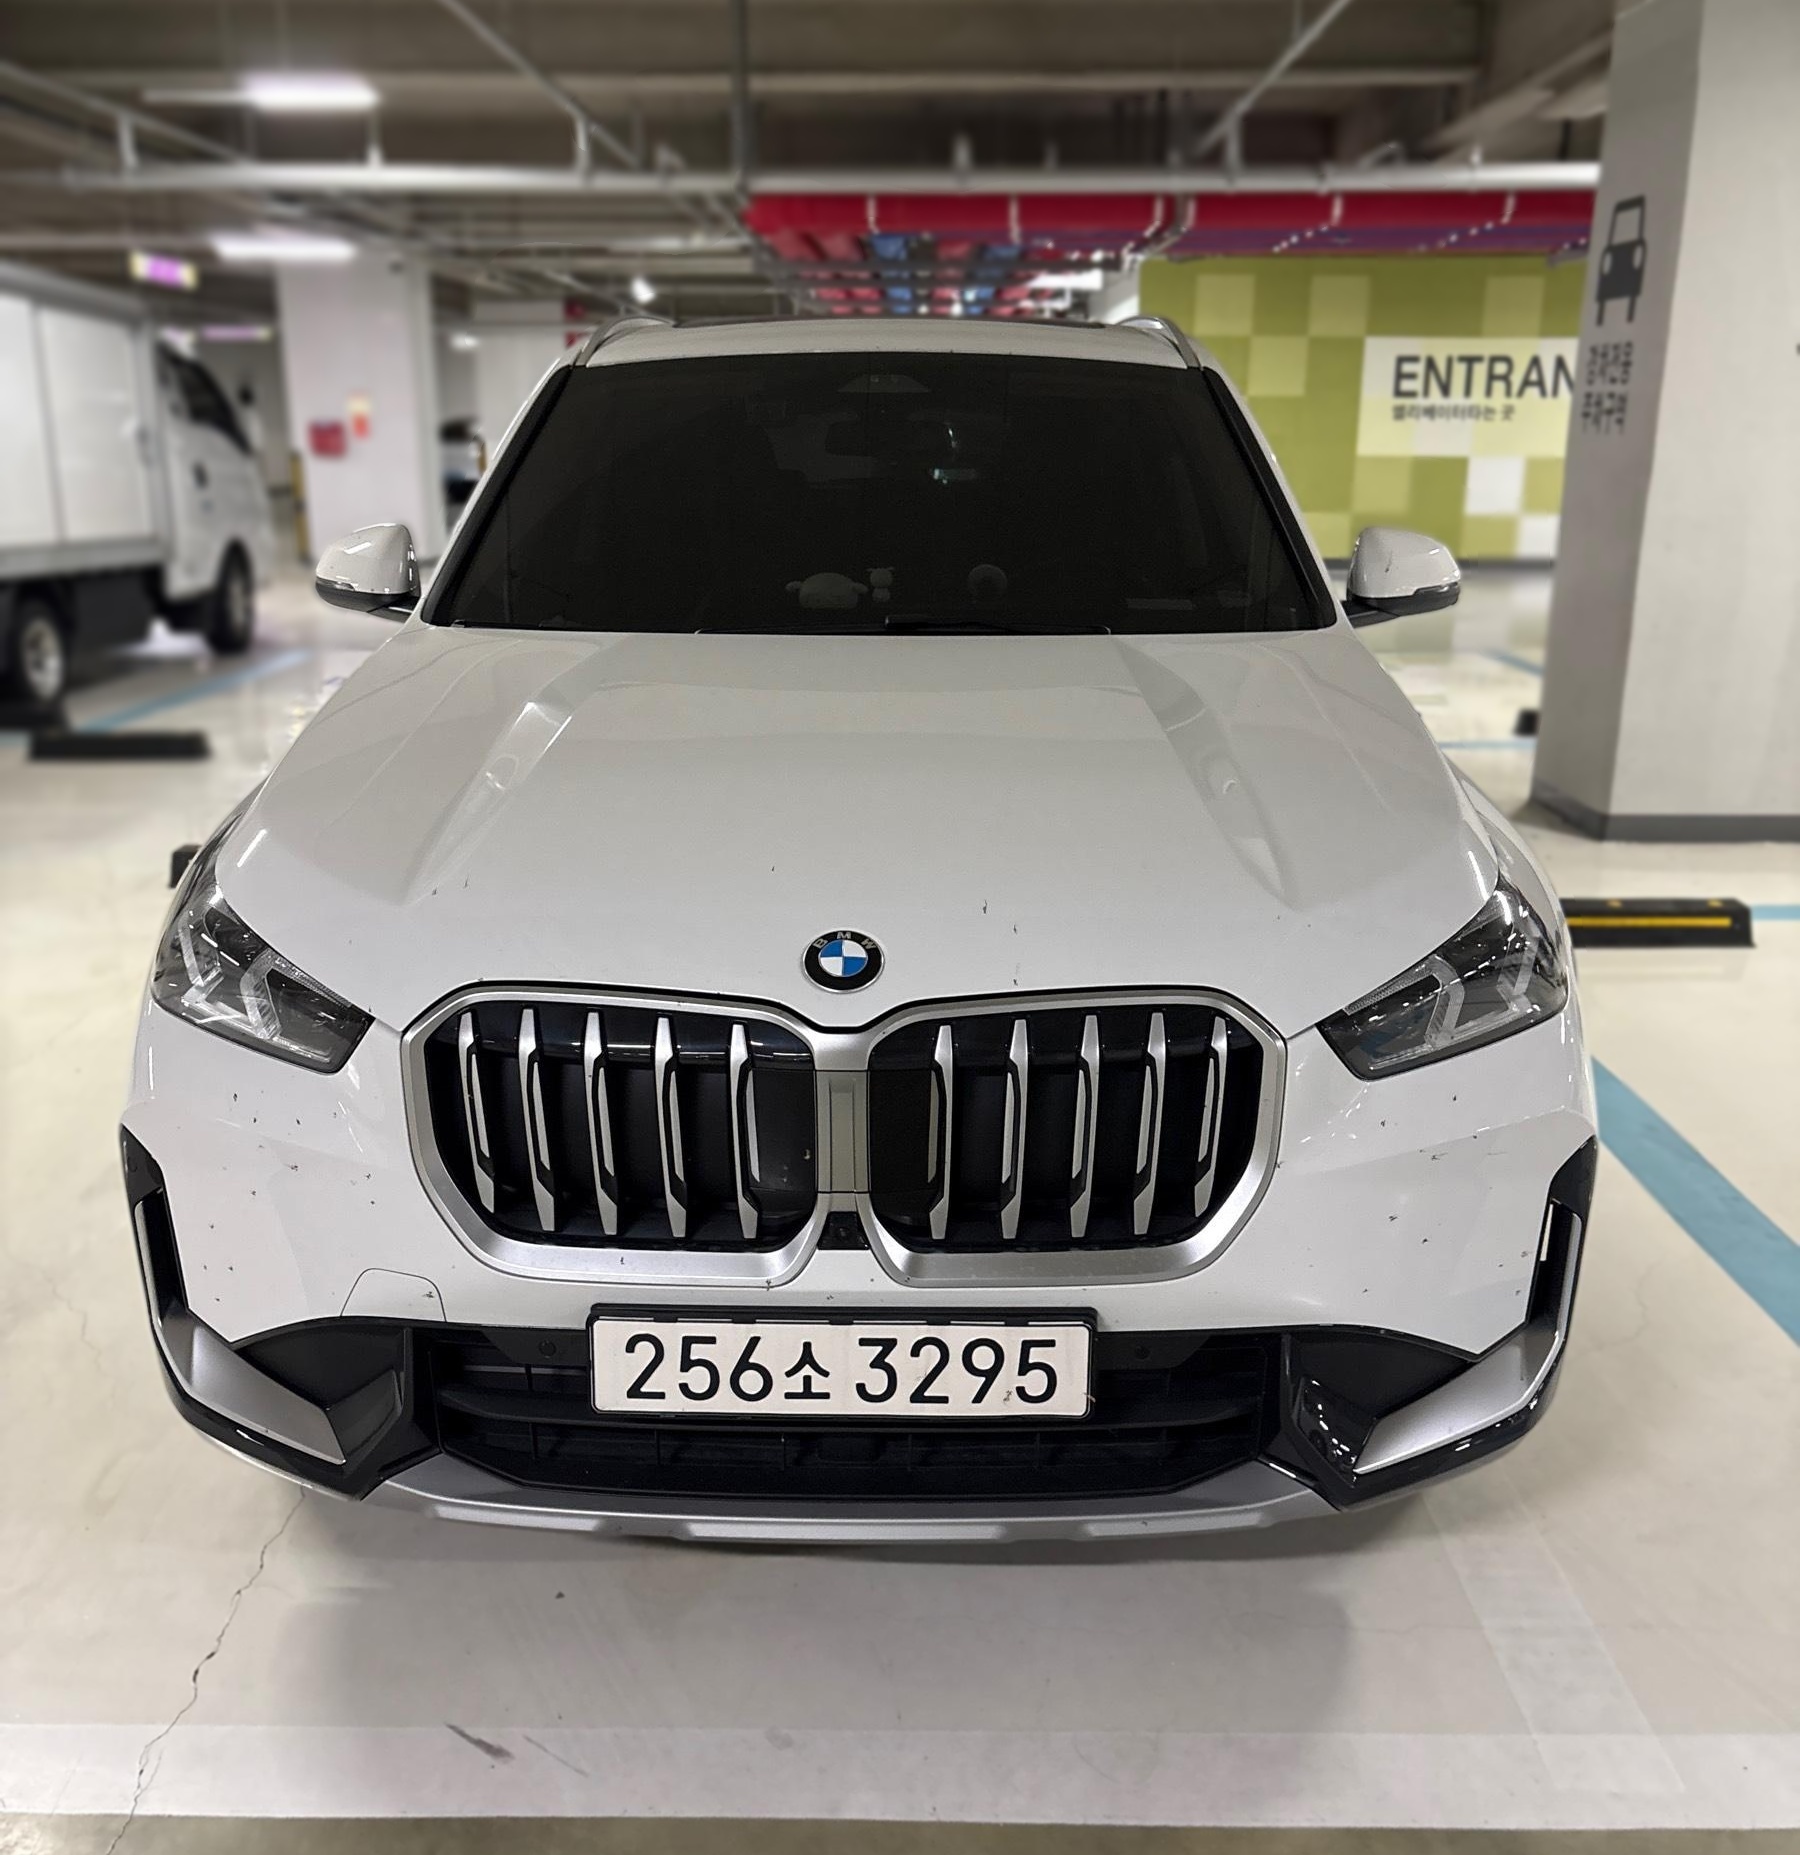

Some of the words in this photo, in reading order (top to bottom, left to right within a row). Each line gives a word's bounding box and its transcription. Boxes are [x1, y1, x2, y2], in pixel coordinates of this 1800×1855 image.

[813, 931, 876, 950] BMW
[625, 1333, 831, 1402] 256소
[855, 1337, 1058, 1404] 3295
